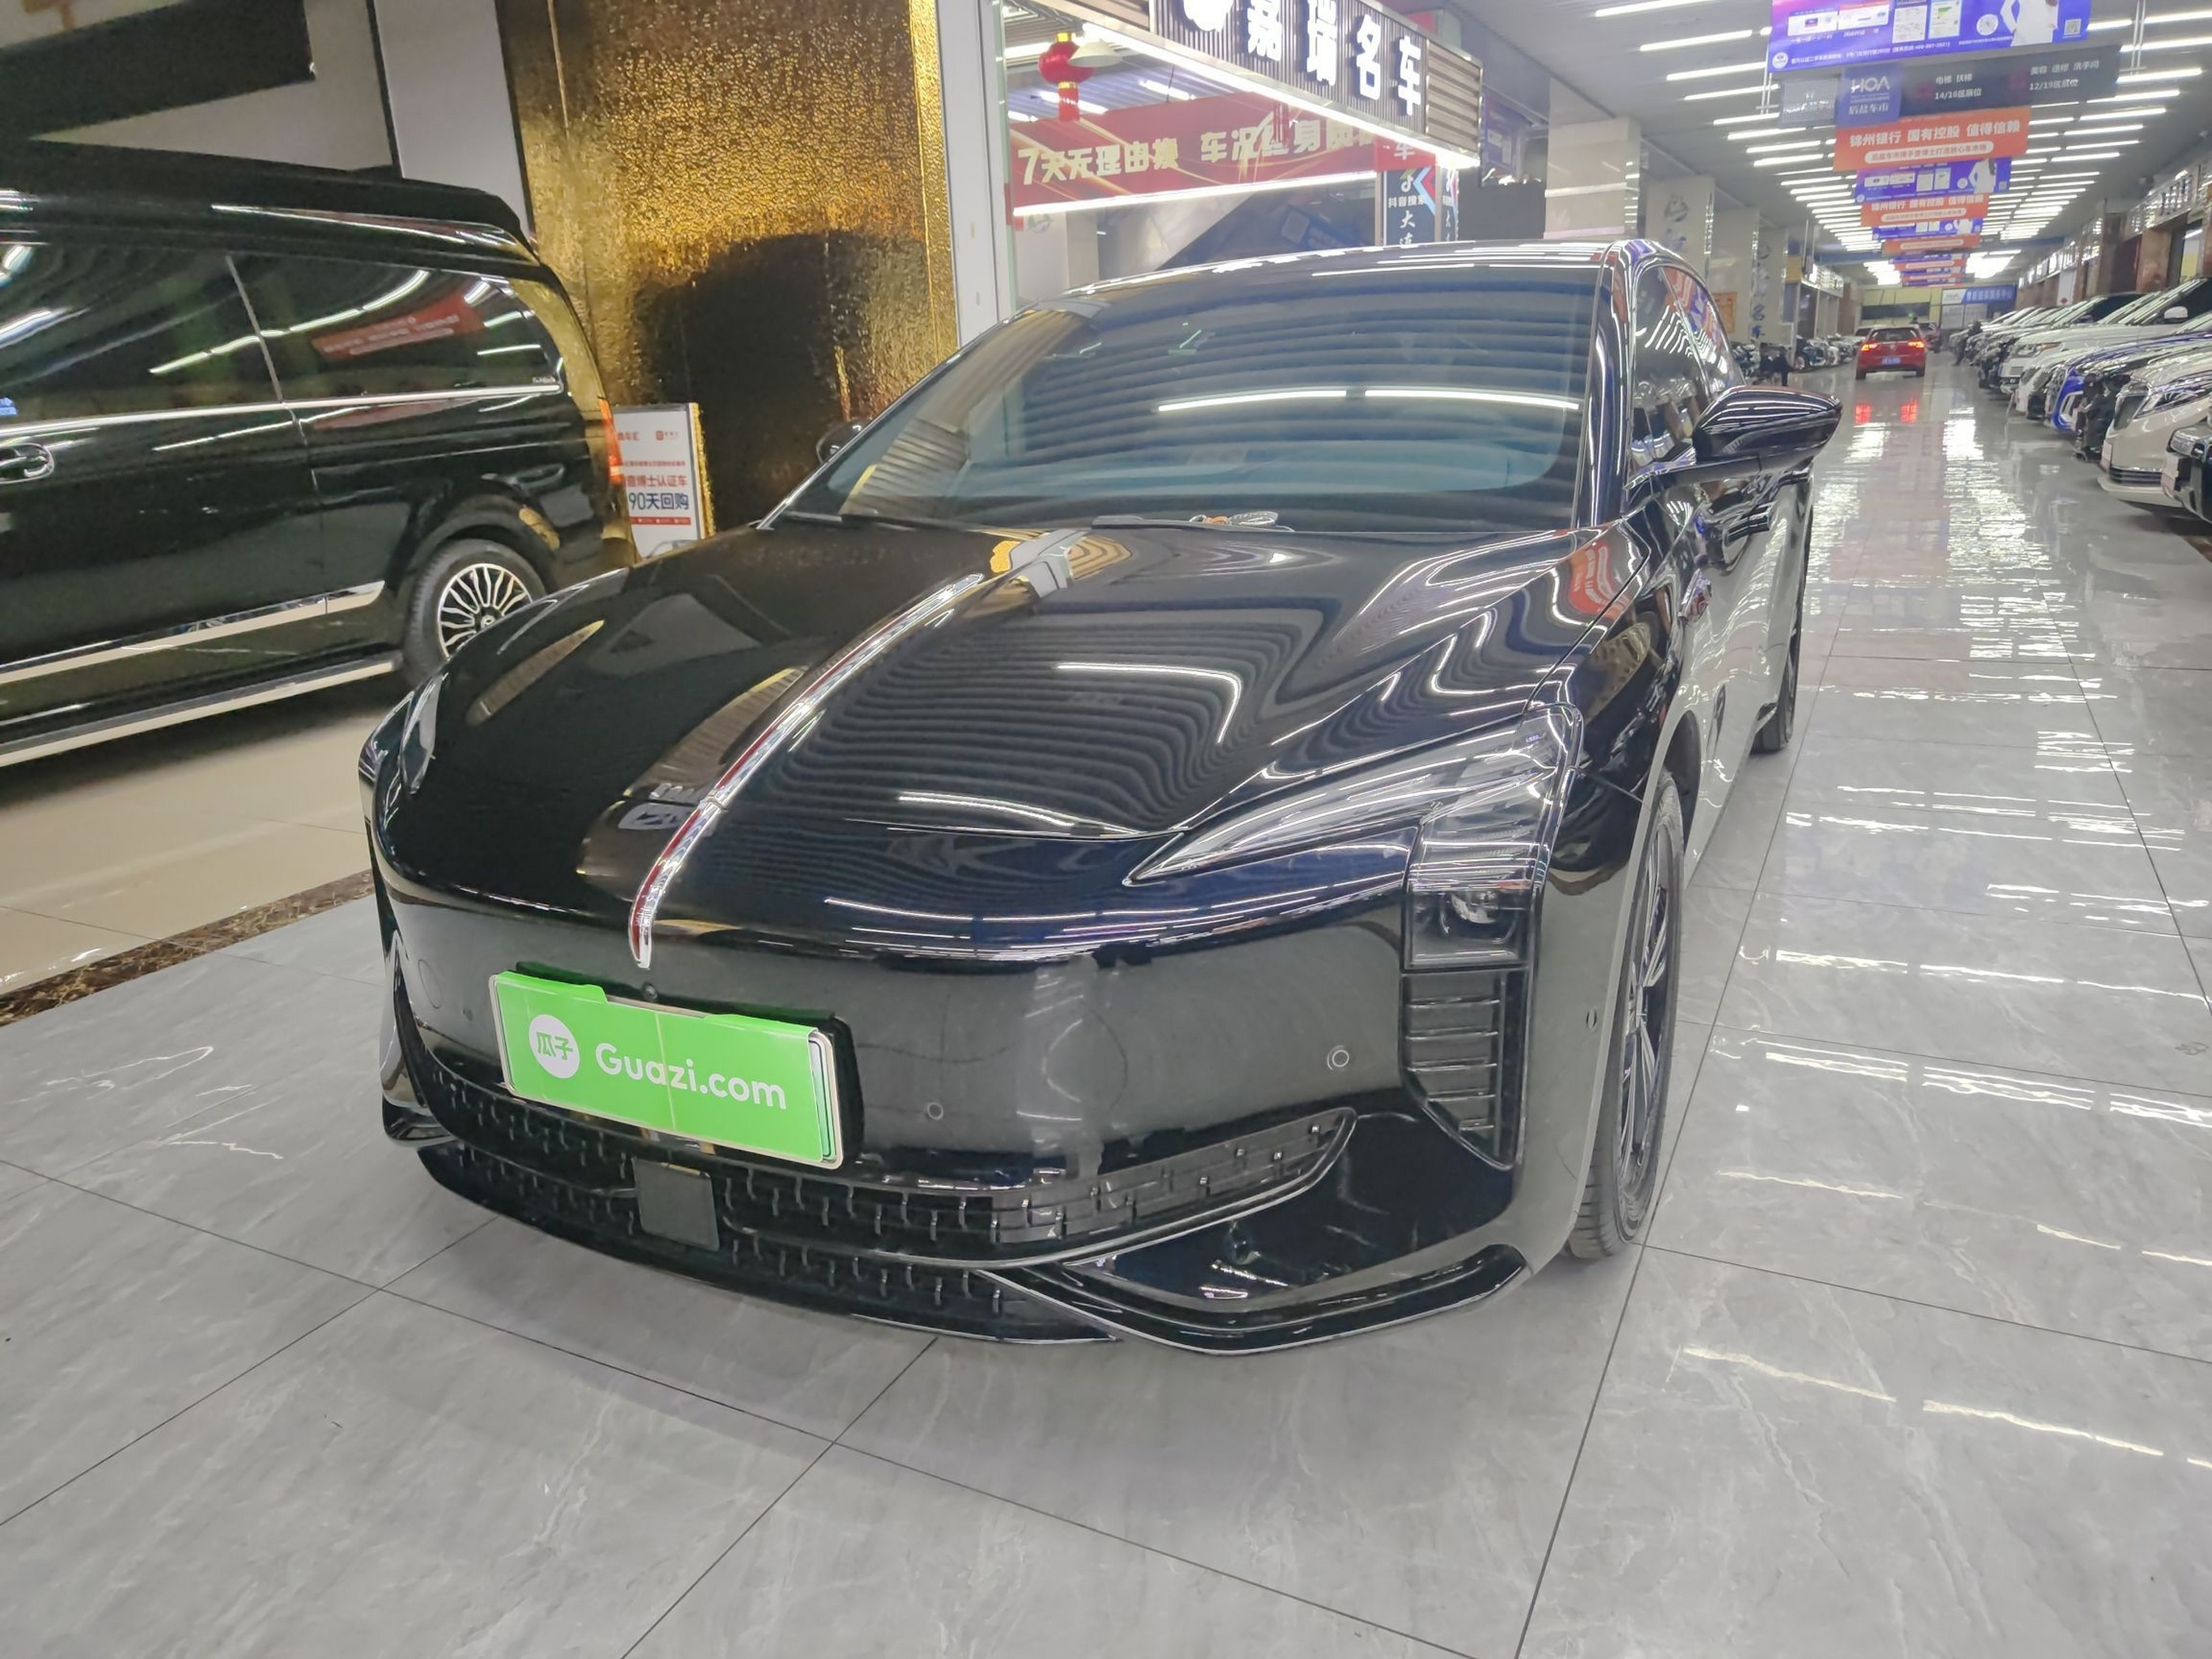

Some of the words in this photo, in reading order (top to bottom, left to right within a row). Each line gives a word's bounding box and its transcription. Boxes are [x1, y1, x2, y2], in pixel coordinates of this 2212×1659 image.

[1849, 130, 1902, 147] 锦州银行
[1907, 125, 1960, 142] 国有控股
[1965, 119, 2021, 137] 值得信赖
[628, 493, 689, 510] 90天回购
[536, 1031, 574, 1061] 瓜子
[596, 1042, 787, 1110] Guazi.com
